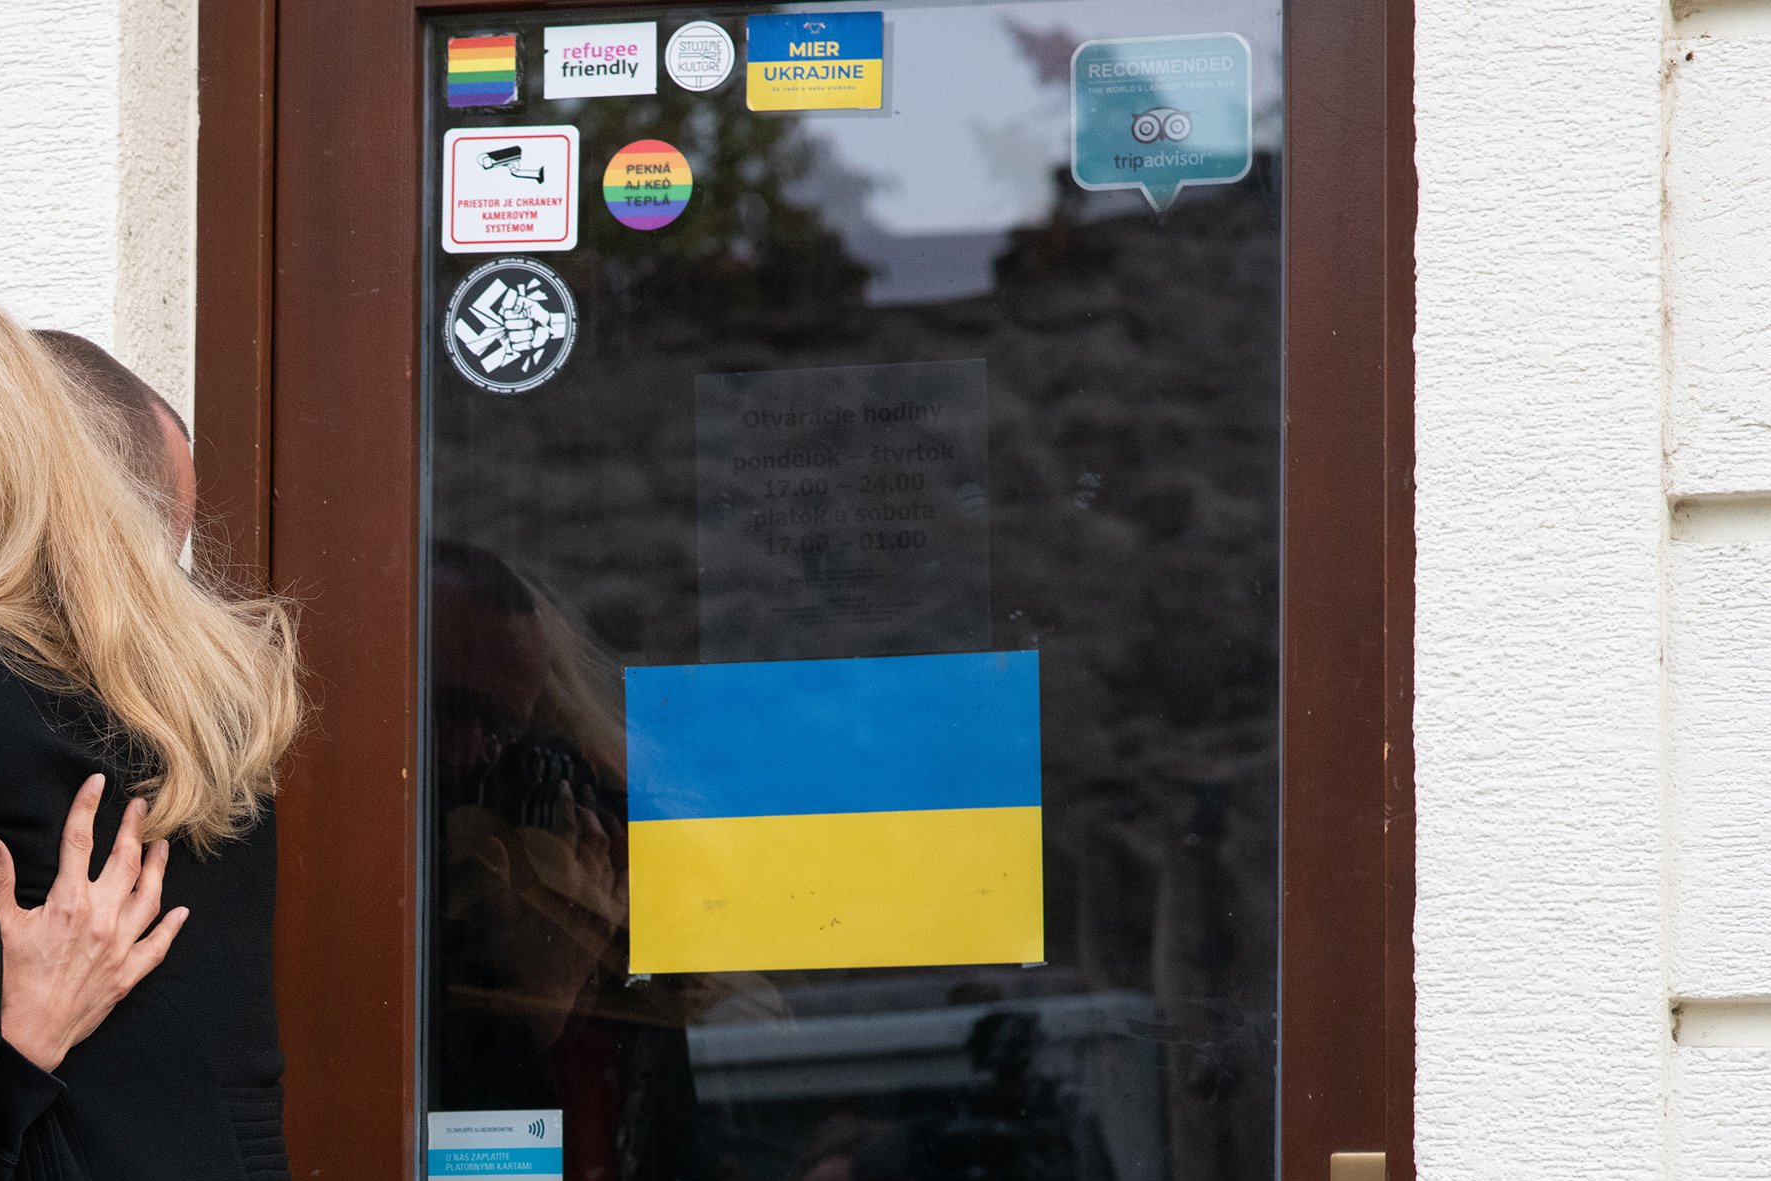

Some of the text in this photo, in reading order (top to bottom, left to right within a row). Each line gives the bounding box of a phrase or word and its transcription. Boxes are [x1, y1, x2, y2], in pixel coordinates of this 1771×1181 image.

[563, 42, 638, 62] refugee
[788, 41, 840, 57] MIER
[562, 59, 638, 78] friendly
[764, 65, 864, 81] UKRAJINE
[1088, 55, 1234, 79] RECOMMENDED
[626, 161, 671, 174] PEKNÁ
[1113, 151, 1207, 171] tripadvisor
[624, 180, 640, 190] AJ
[458, 198, 500, 208] PRIESTOR
[503, 198, 513, 208] JE
[625, 193, 670, 207] TEPLÁ
[743, 400, 943, 430] Otváracie hodiny
[733, 447, 840, 473] pondelok
[871, 441, 954, 464] štvrtok
[763, 477, 829, 498] 17.00
[858, 473, 926, 494] 24.00
[754, 499, 935, 531] piatok a sobota
[764, 533, 830, 555] 17.00
[859, 529, 927, 551] 01.00
[446, 1154, 452, 1162] U
[496, 1162, 532, 1170] KARTAMI
